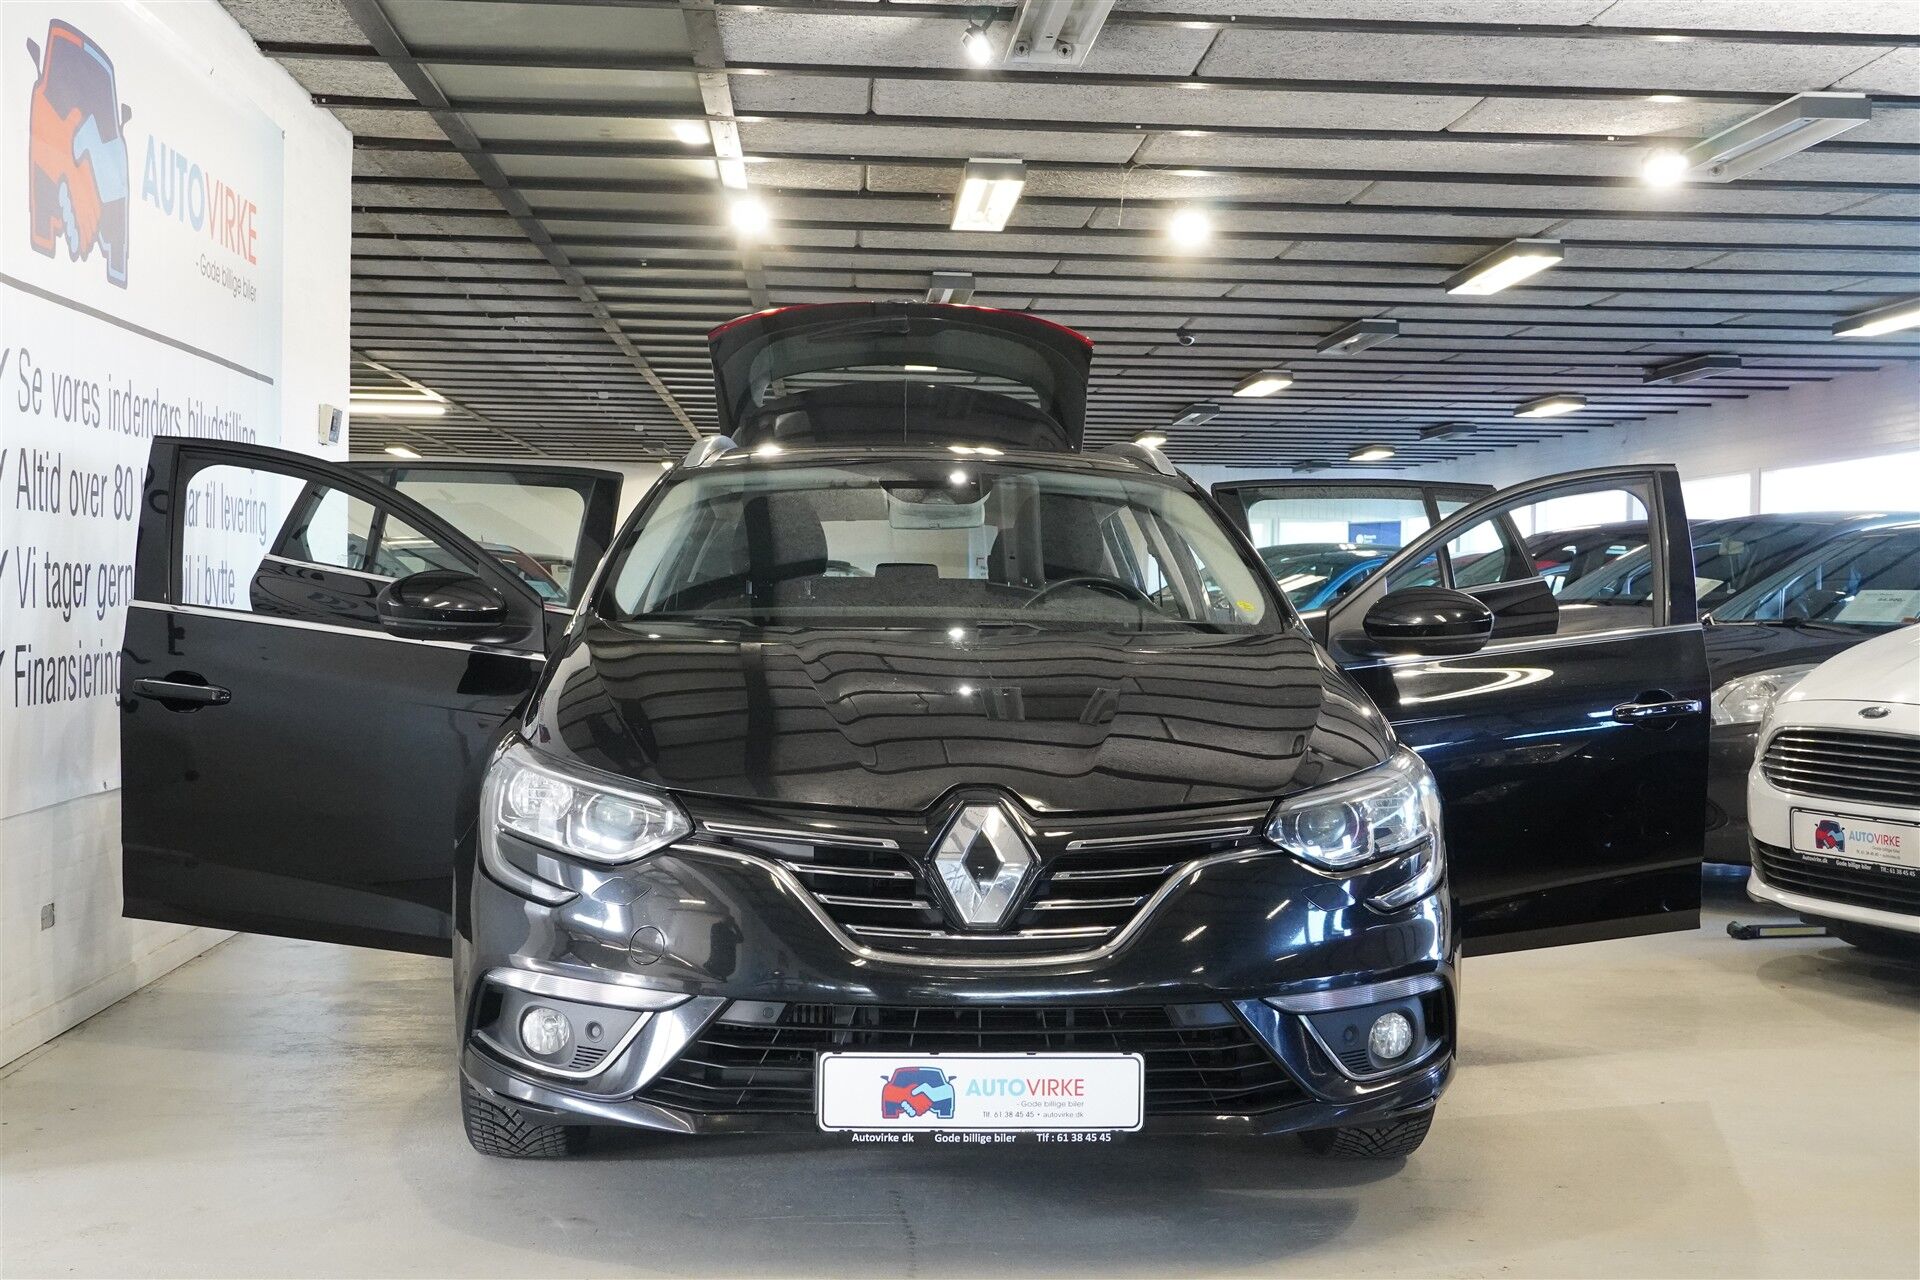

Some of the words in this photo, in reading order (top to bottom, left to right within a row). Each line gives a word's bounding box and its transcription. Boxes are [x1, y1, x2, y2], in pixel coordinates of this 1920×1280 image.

[142, 134, 257, 266] AUTOVIRKE
[200, 253, 221, 283] Gode
[222, 265, 241, 298] billige
[17, 348, 42, 415] Se
[52, 372, 100, 429] vores
[108, 374, 182, 438] indendørs
[16, 447, 61, 514] Altid
[69, 469, 108, 518] over
[114, 463, 134, 521] 80
[206, 481, 216, 529] til
[221, 483, 267, 546] levering
[17, 546, 36, 608] Vi
[44, 551, 91, 622] tager
[97, 563, 133, 621] gern
[197, 555, 200, 604] i
[205, 555, 235, 606] bytte
[15, 638, 121, 708] Finansiering
[1849, 830, 1900, 848] AUTOVIRKE
[965, 1078, 1085, 1097] AUTOVIRKE
[851, 1132, 900, 1143] Autovirke
[934, 1132, 961, 1143] Gode
[962, 1132, 992, 1145] billige
[993, 1132, 1017, 1143] biler
[1036, 1132, 1050, 1142] Tlf
[1056, 1132, 1069, 1142] 61
[1070, 1132, 1084, 1142] 38
[1084, 1132, 1098, 1142] 45
[1098, 1132, 1113, 1142] 45
